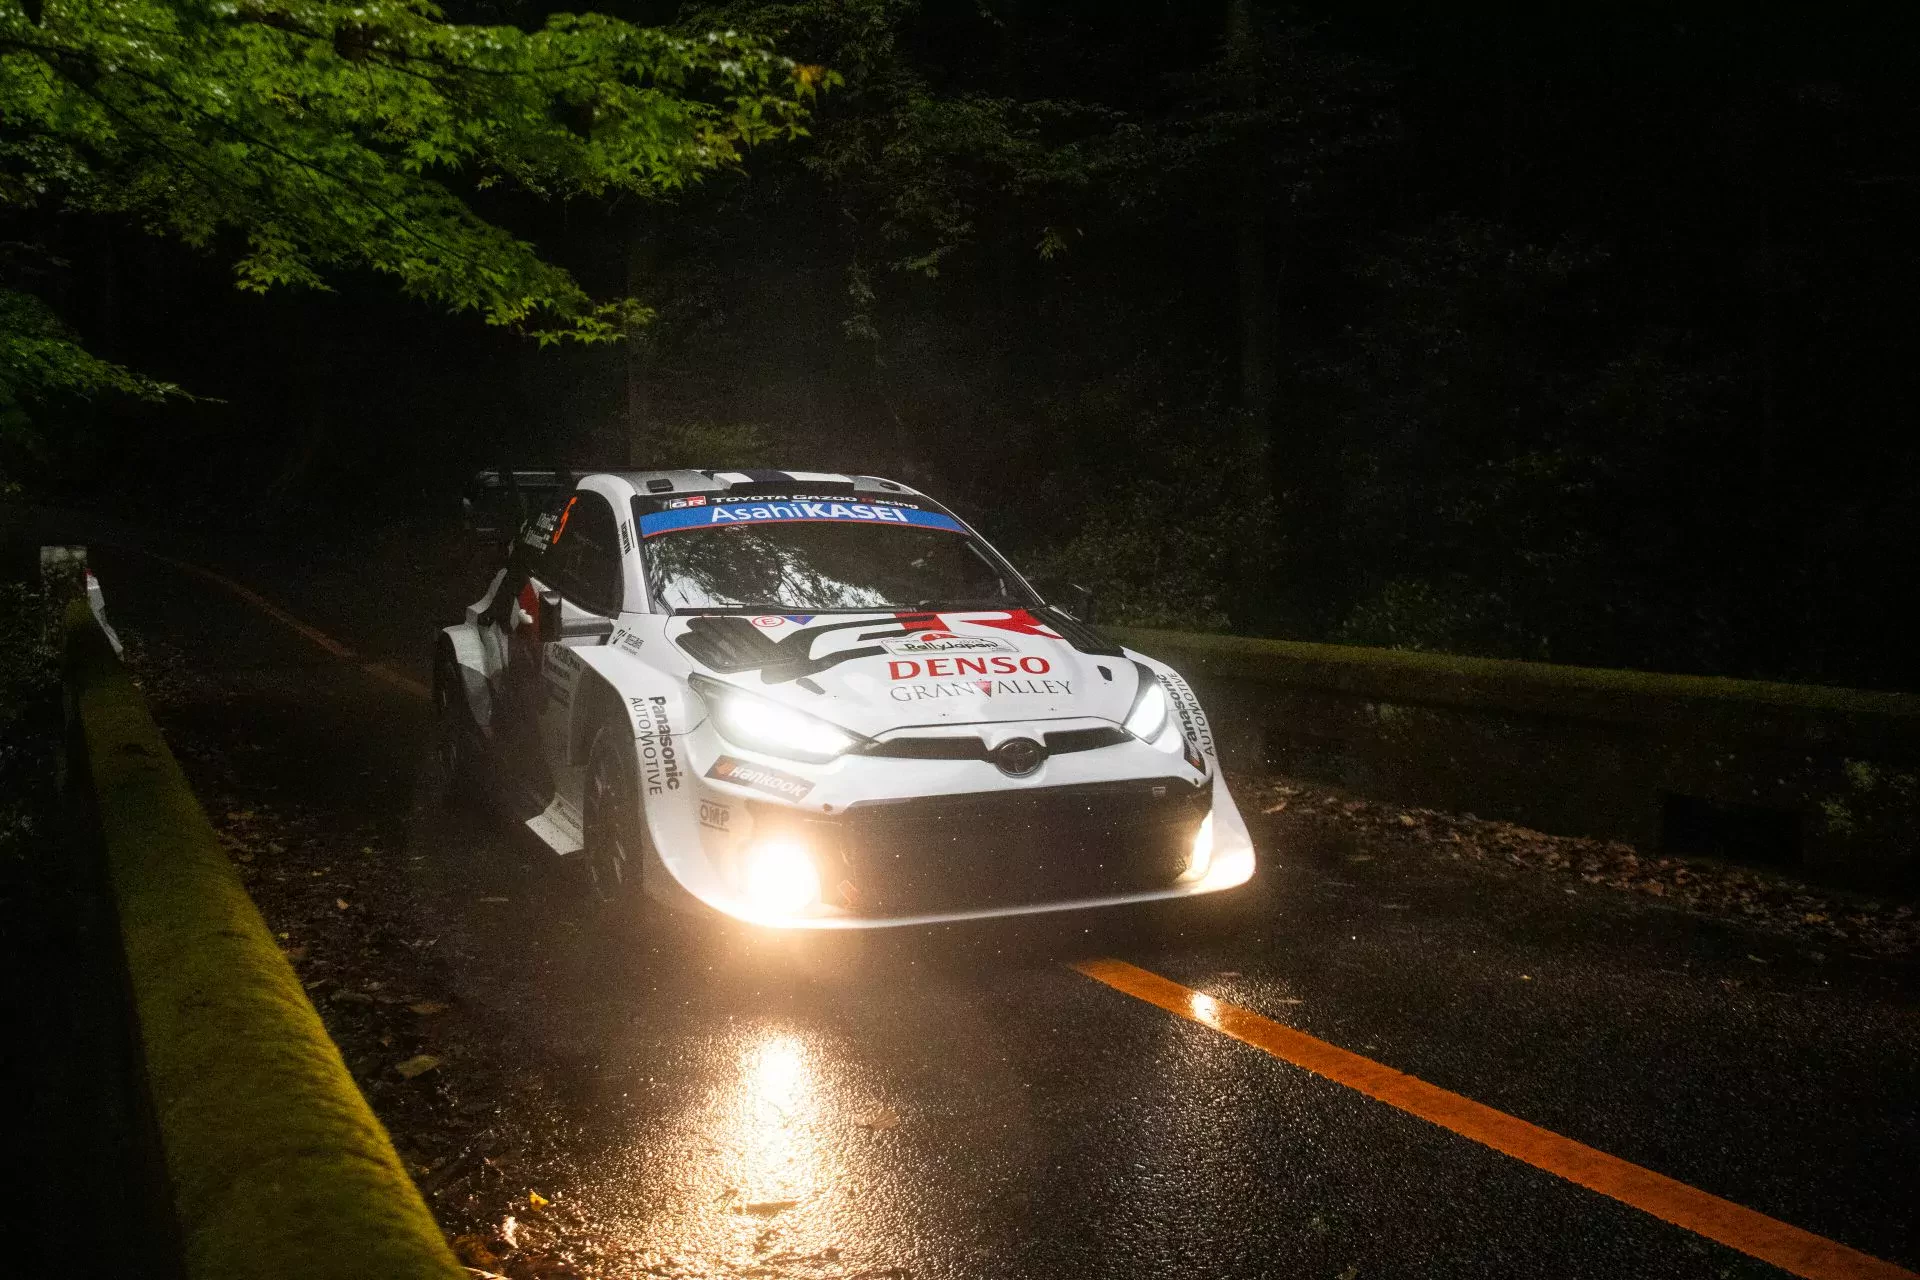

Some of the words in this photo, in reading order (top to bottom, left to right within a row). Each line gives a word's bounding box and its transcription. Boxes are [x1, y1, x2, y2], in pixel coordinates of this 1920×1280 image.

[671, 496, 707, 508] GR
[714, 495, 787, 504] TOYOTA
[711, 502, 909, 523] AsahiKASEI
[887, 656, 1051, 681] DENSO
[1167, 672, 1215, 757] AUTOMOTIVE
[630, 697, 663, 796] AUTOMOTIVE
[649, 695, 683, 791] Panasonic
[700, 804, 730, 827] OMP
